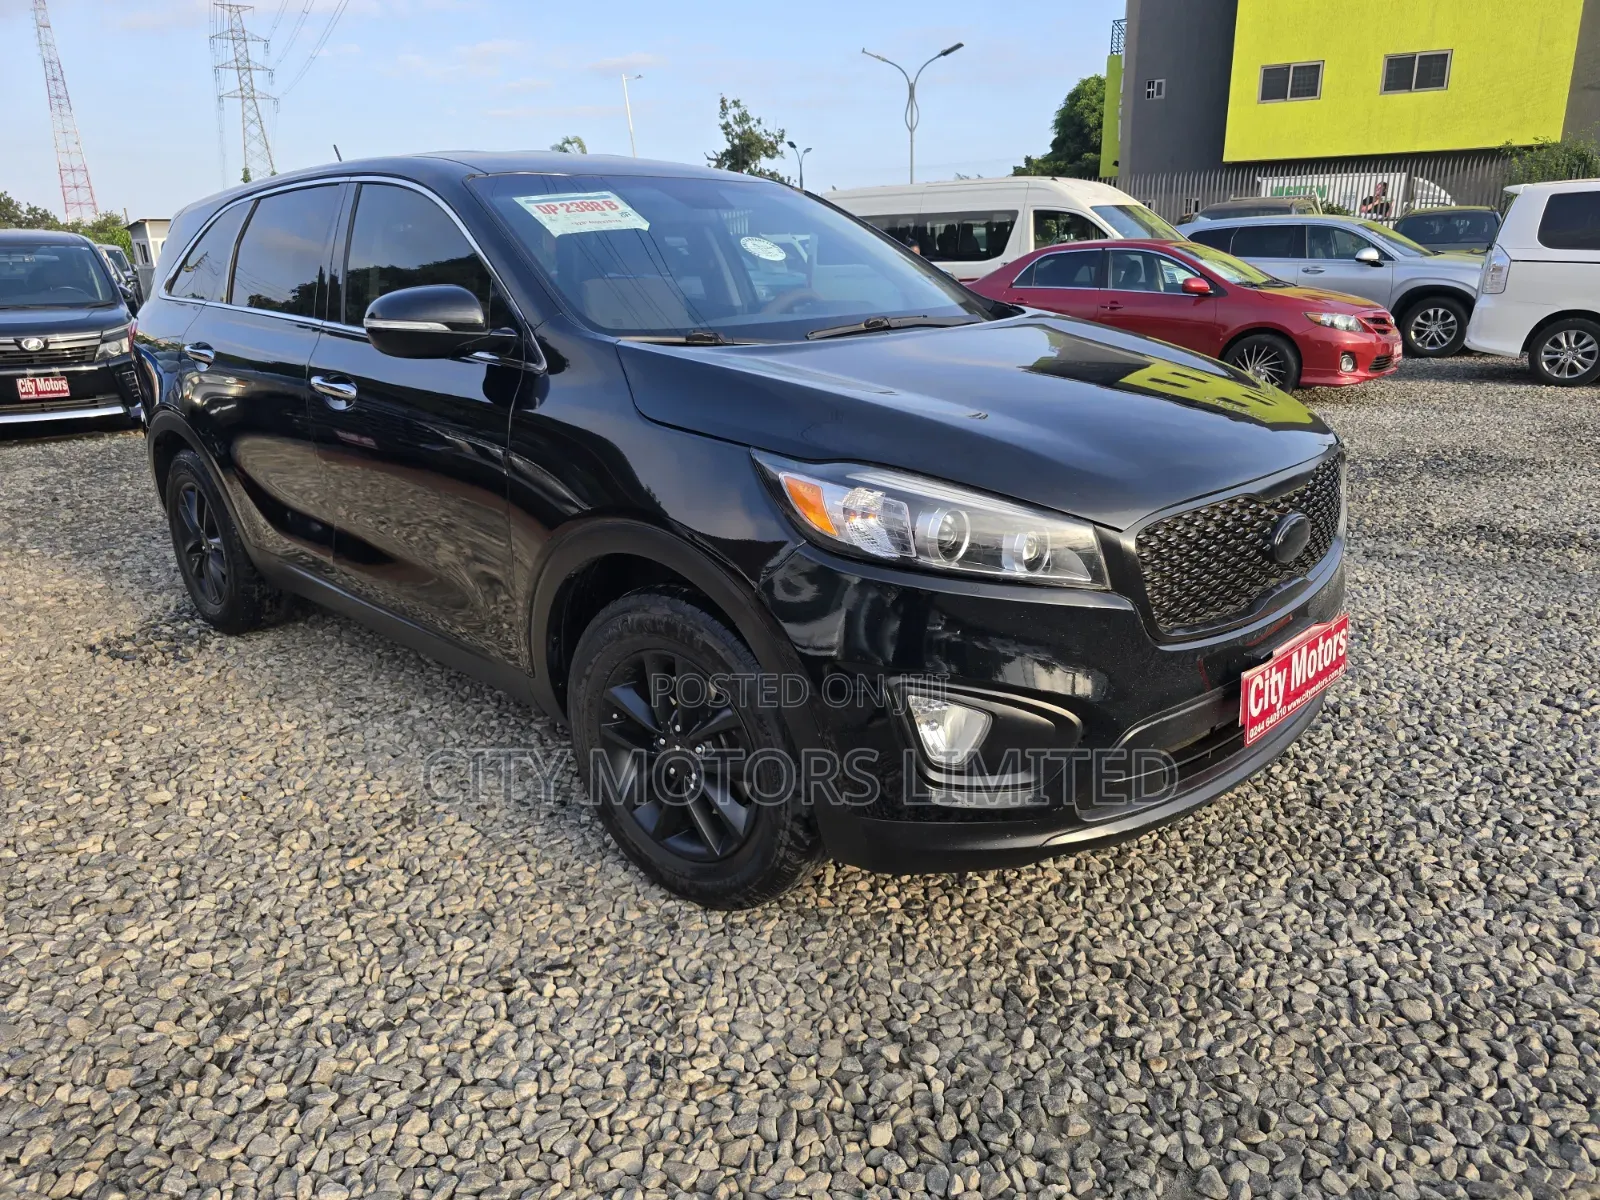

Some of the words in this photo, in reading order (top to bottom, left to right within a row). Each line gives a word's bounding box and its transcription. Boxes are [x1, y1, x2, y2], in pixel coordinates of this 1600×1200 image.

[19, 378, 36, 395] City
[36, 377, 69, 392] Motors
[1250, 666, 1288, 717] City
[1290, 628, 1347, 692] Motors
